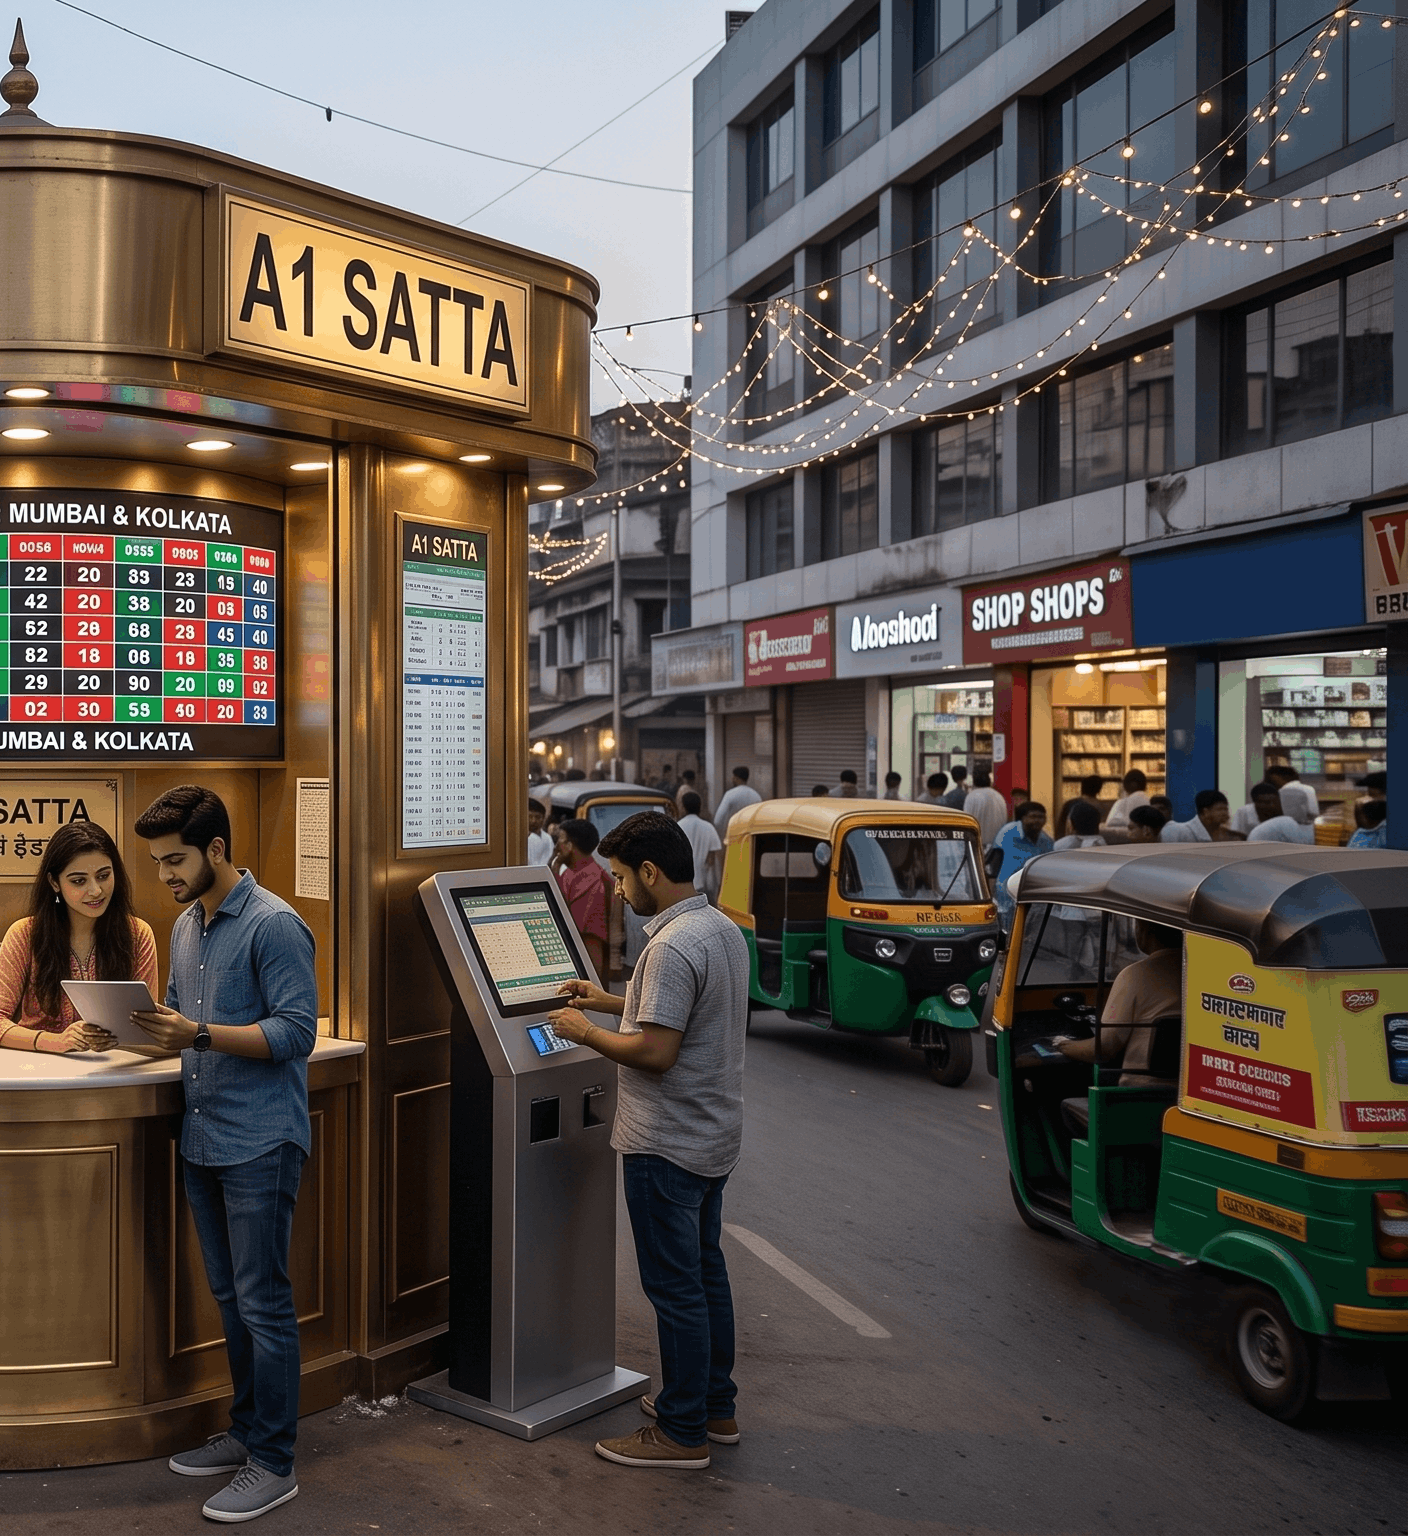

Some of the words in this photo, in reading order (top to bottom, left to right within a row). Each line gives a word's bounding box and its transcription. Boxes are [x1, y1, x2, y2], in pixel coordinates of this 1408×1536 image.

[239, 232, 314, 337] A1
[342, 259, 518, 387] SATTA
[9, 503, 106, 525] MUMBAI
[112, 505, 129, 526] &
[136, 506, 233, 535] KOLKATA
[412, 533, 428, 555] A1
[432, 536, 478, 562] SATTA
[24, 566, 48, 582] 22
[77, 566, 101, 583] 20
[175, 571, 195, 588] 23
[252, 579, 268, 595] 40
[24, 593, 48, 609] 42
[77, 593, 101, 610] 20
[128, 595, 151, 612] 38
[175, 597, 196, 614] 20
[217, 601, 235, 617] 03
[971, 591, 1025, 632] SHOP
[1030, 577, 1105, 623] SHOPS
[128, 622, 151, 638] 68
[217, 626, 235, 643] 45
[252, 629, 268, 645] 40
[25, 647, 48, 663] 82
[78, 647, 101, 664] 18
[217, 652, 235, 668] 35
[24, 674, 48, 690] 29
[77, 674, 101, 690] 20
[128, 675, 150, 691] 90
[175, 676, 196, 692] 20
[24, 701, 48, 717] 02
[77, 701, 100, 717] 30
[217, 704, 235, 719] 20
[71, 731, 88, 750] &
[94, 731, 194, 751] KOLKATA
